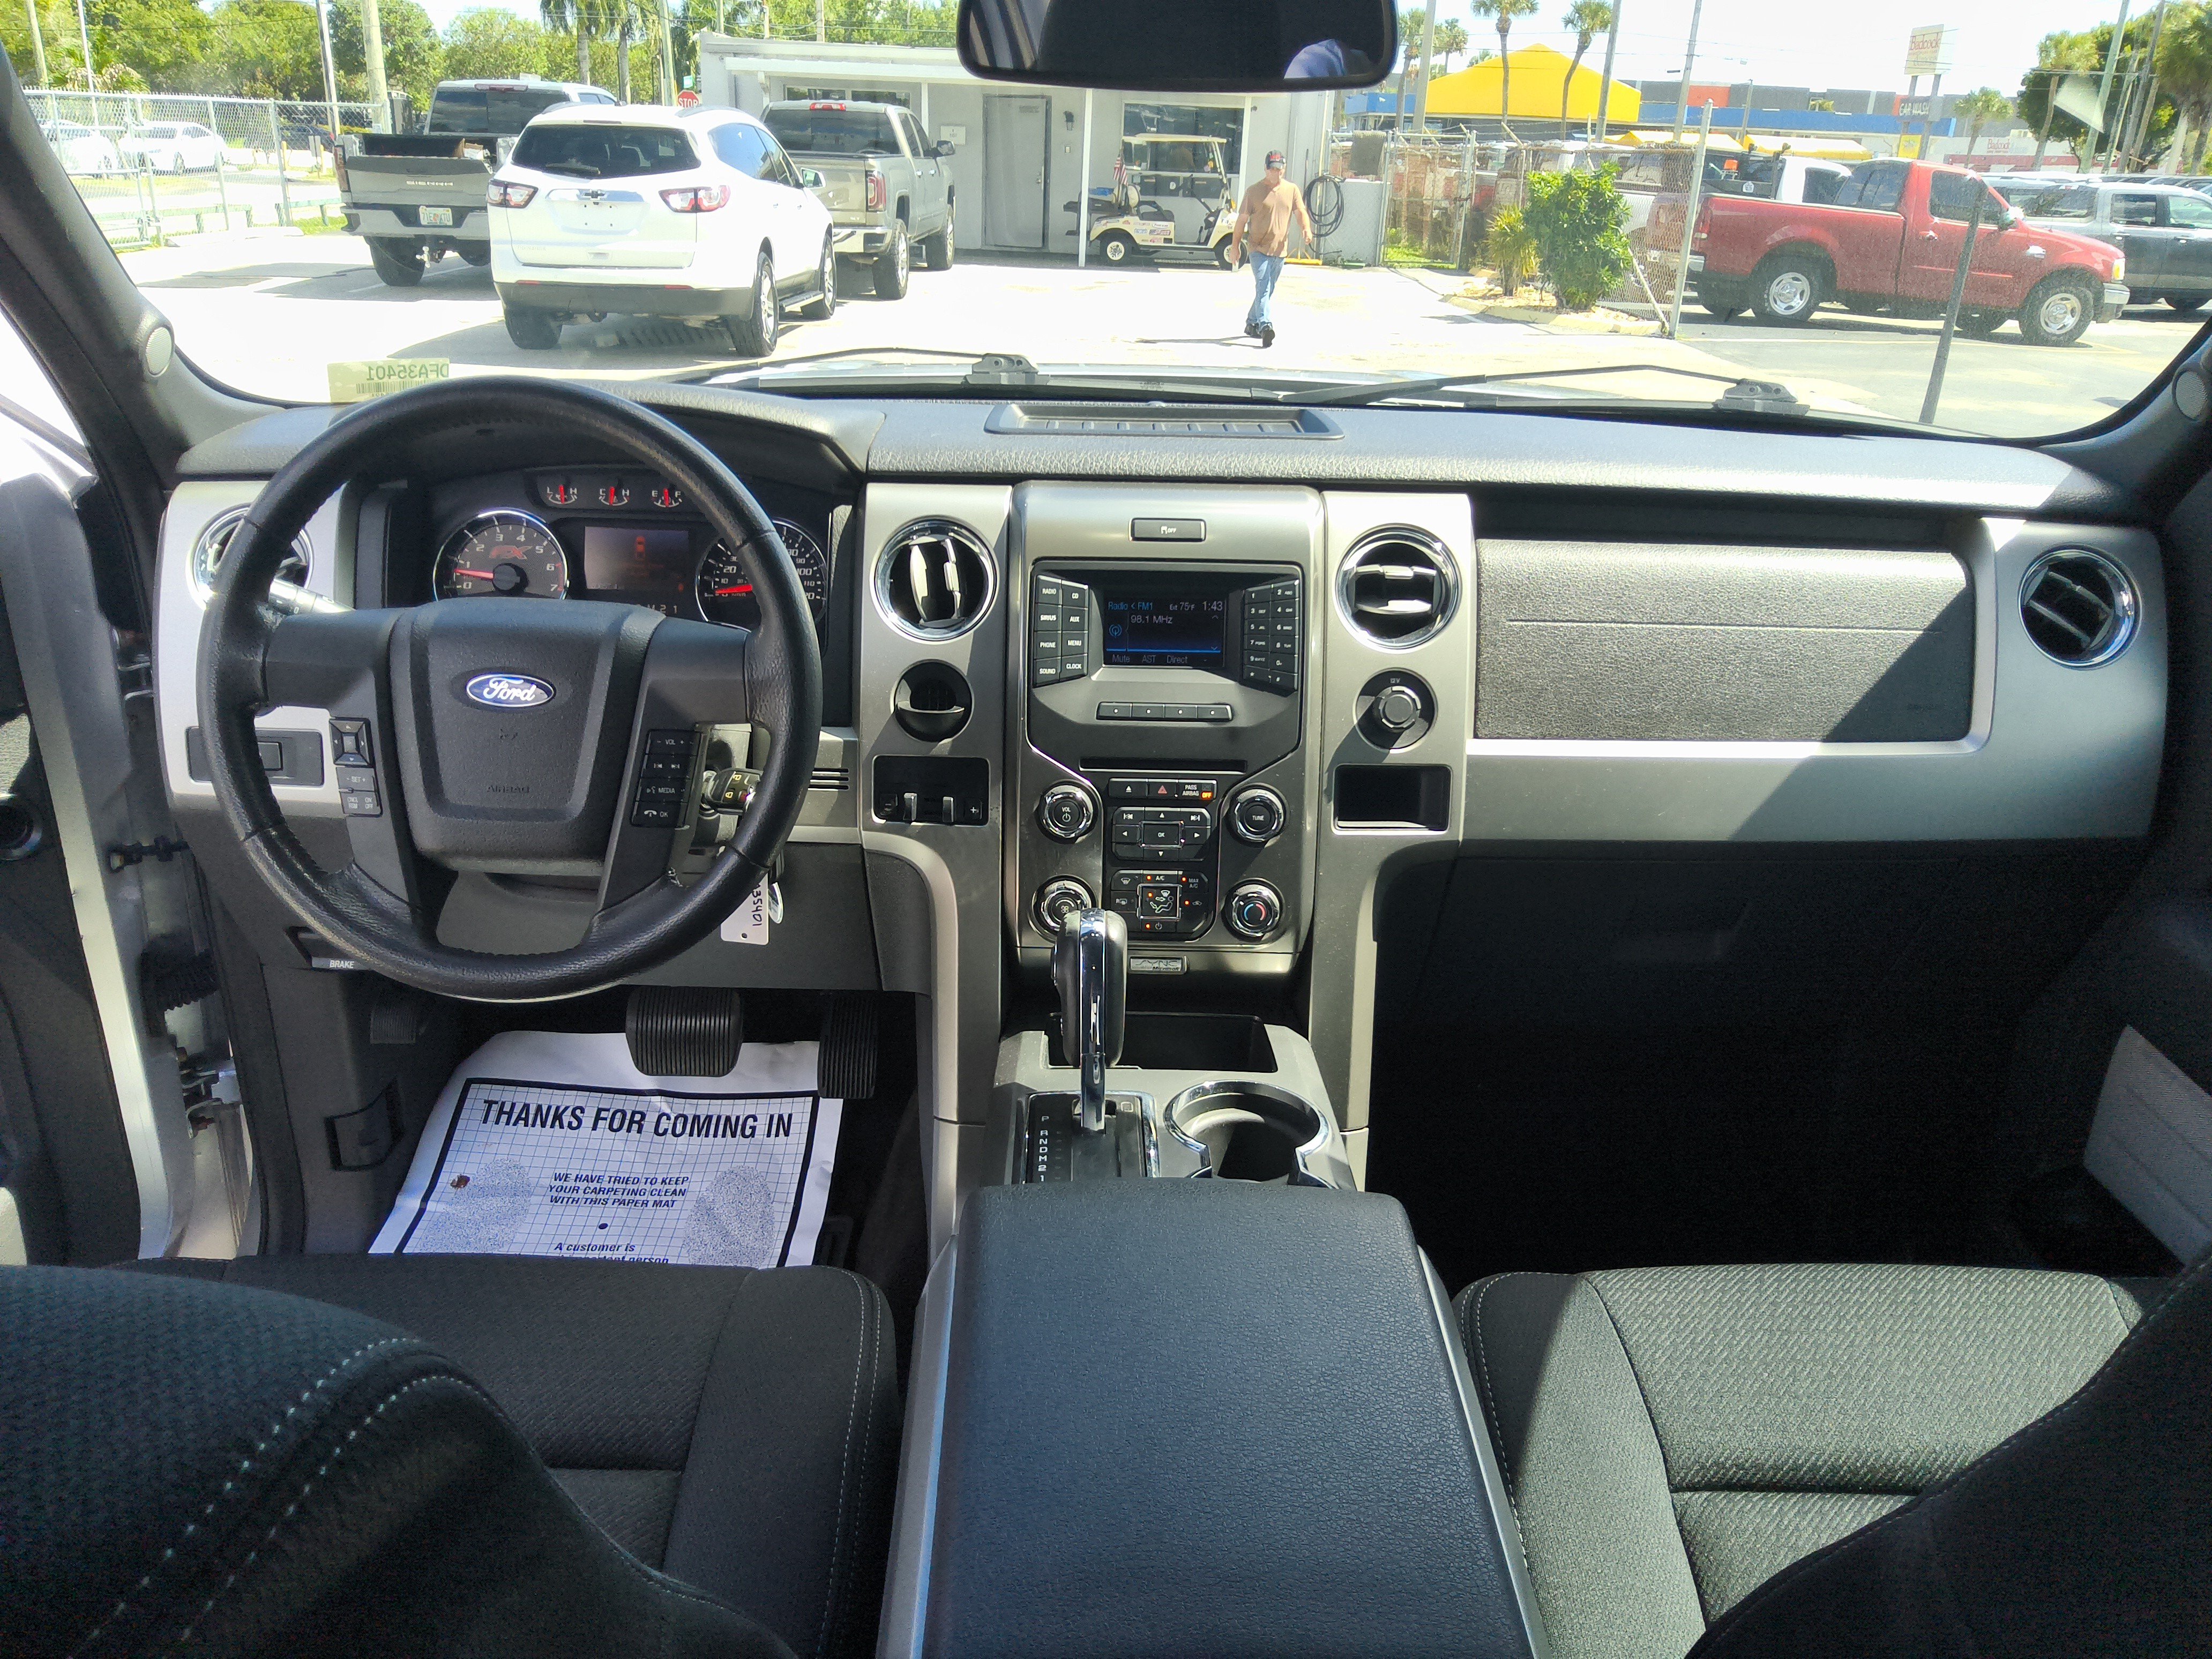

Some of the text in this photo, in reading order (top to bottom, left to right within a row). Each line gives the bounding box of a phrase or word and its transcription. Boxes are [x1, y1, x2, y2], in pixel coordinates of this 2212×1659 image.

[1909, 33, 1941, 50] Badcock
[678, 98, 698, 108] STOP
[1899, 103, 1912, 116] CAR
[547, 486, 553, 494] L
[495, 534, 504, 542] 3
[517, 534, 526, 542] 4
[660, 604, 667, 614] 2
[674, 605, 678, 614] 1
[1108, 601, 1128, 610] Radio
[1138, 602, 1153, 610] FM1
[1202, 601, 1223, 611] 1:43
[1130, 615, 1173, 624] 98.1 MHz
[1112, 654, 1188, 663] Mute AST Direct
[483, 677, 537, 702] Ford
[329, 960, 355, 969] BRAKE
[482, 1099, 793, 1139] THANKS FOR COMING IN
[554, 1172, 689, 1186] WE HAVE TRIED TO KEEP
[549, 1185, 687, 1197] YOUR CARPETING CLEAN
[550, 1195, 677, 1208] WITH THIS PAPER MAT
[554, 1242, 636, 1252] A customer is
